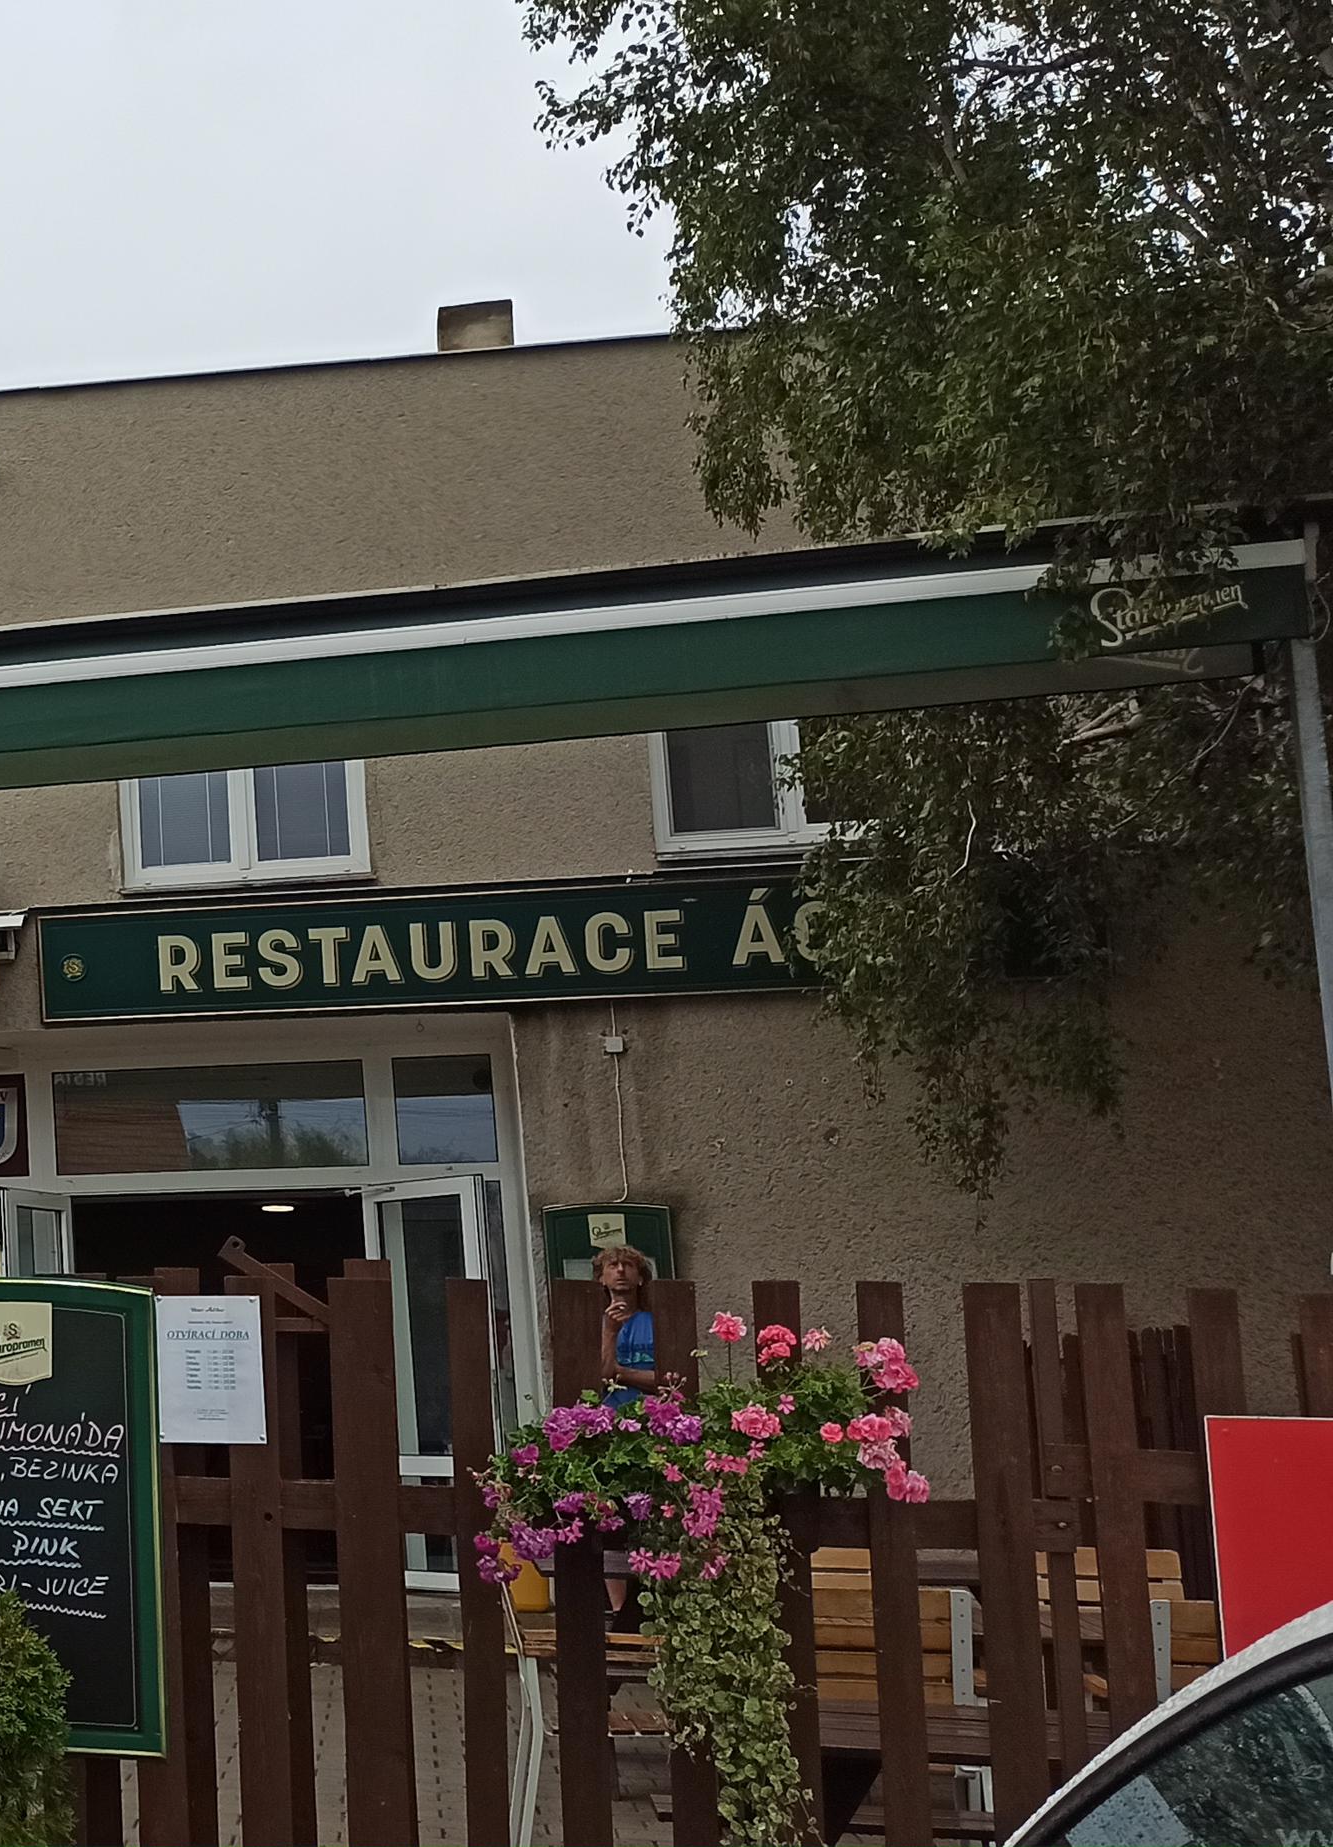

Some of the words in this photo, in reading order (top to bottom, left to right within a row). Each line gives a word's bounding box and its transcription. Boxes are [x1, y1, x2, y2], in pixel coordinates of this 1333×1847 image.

[157, 909, 688, 993] RESTAURACE
[36, 1497, 105, 1521] SEKT
[11, 1530, 80, 1559] PINK
